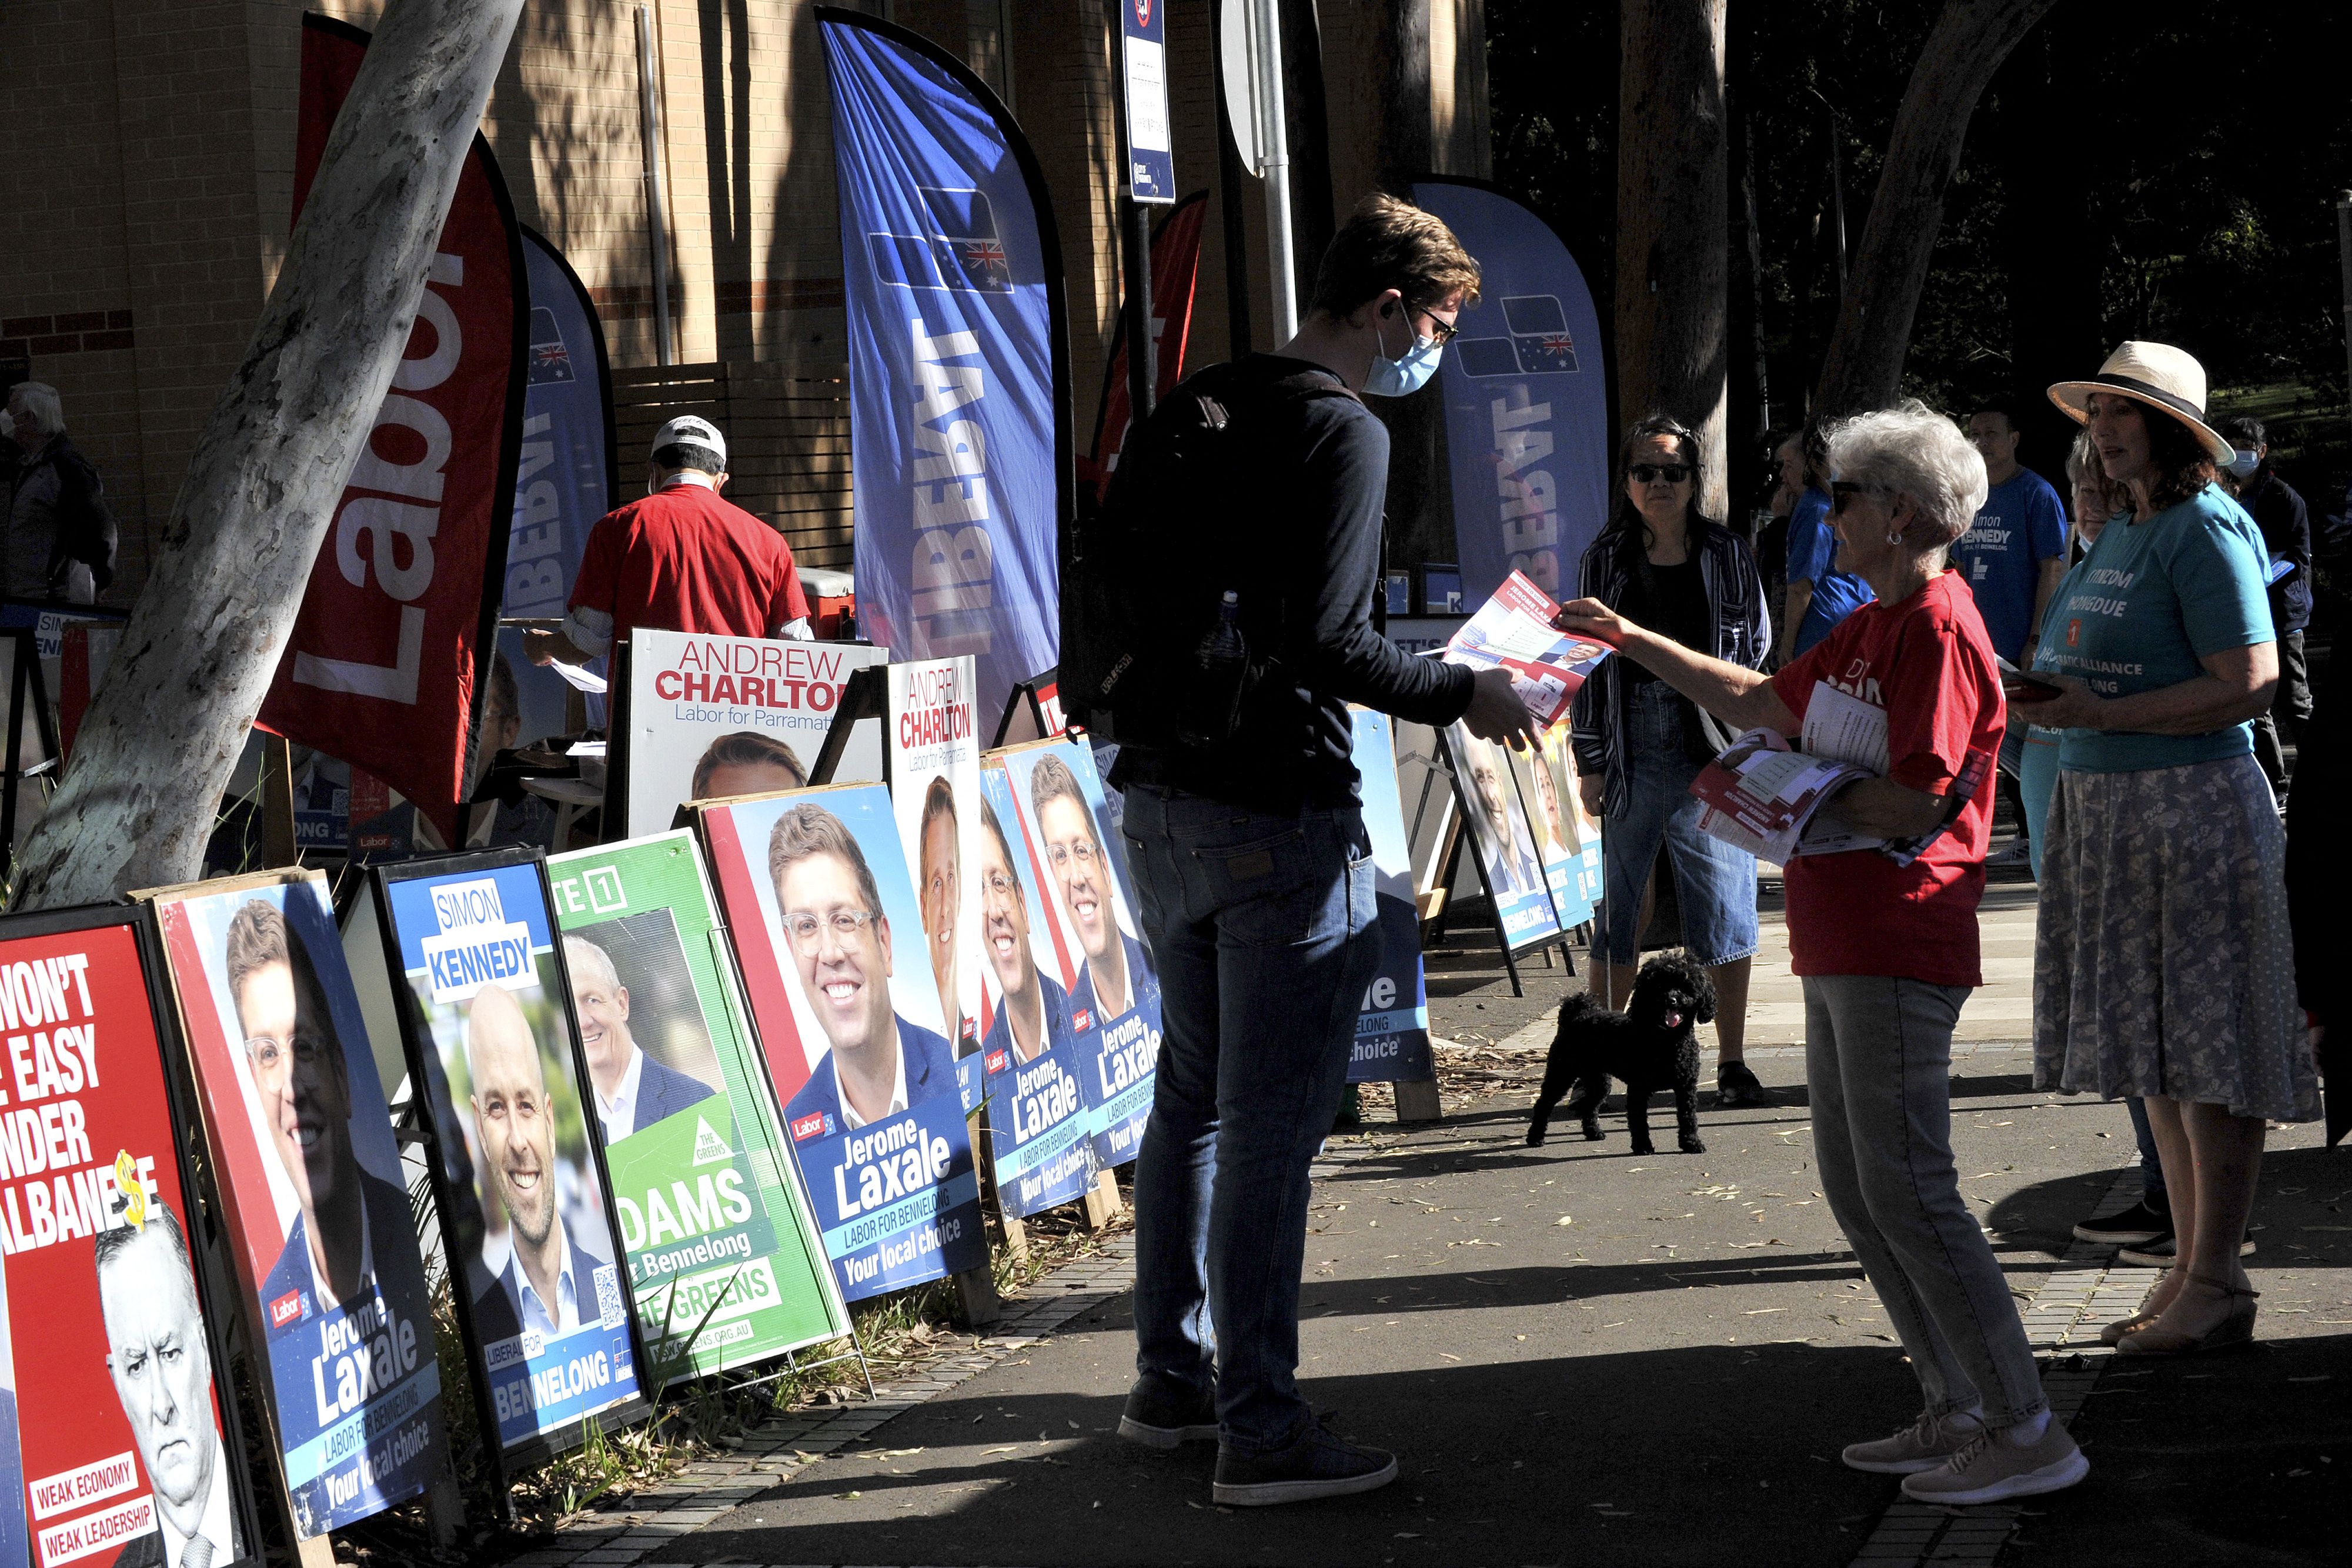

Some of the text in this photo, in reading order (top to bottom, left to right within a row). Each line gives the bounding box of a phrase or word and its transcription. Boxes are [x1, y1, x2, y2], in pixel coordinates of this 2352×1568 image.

[1506, 590, 1522, 604] LABOR
[1521, 601, 1531, 612] FOR
[1509, 586, 1536, 610] JEROME
[2070, 625, 2076, 641] 1
[679, 641, 843, 681] ANDREW
[2080, 657, 2142, 676] ALLIANCE
[908, 666, 963, 710] ANDREW
[676, 704, 722, 723] Labor
[728, 707, 750, 724] for
[900, 703, 971, 749] CHARLTON
[910, 747, 966, 772] Labor for Parramatta
[361, 837, 387, 847] Labor
[437, 888, 500, 929] SIMON
[597, 875, 612, 901] 1
[429, 937, 529, 990] KENNEDY
[963, 1021, 973, 1036] Labor
[1101, 1014, 1142, 1057] Jerome
[8, 1023, 99, 1102] EASY
[988, 1055, 1003, 1071] Labor
[1015, 1058, 1057, 1101] Jerome
[1097, 1022, 1161, 1100] Laxale
[1011, 1066, 1077, 1145] Laxale
[1107, 1098, 1127, 1123] LABOR
[1127, 1092, 1138, 1111] FOR
[700, 1134, 714, 1146] THE
[794, 1118, 821, 1138] Labor
[844, 1118, 917, 1170] Jerome
[1020, 1120, 1078, 1170] LABOR FOR BENNELONG
[1108, 1125, 1130, 1154] Your
[696, 1144, 726, 1160] GREENS
[834, 1127, 951, 1221] Laxale
[1020, 1174, 1043, 1202] Your
[1041, 1155, 1064, 1191] local
[1063, 1142, 1085, 1178] choice
[615, 1168, 752, 1254] DAMS
[844, 1188, 950, 1249] LABOR FOR BENNELONG
[642, 1232, 753, 1277] Bennelong
[844, 1252, 879, 1286] Your
[880, 1231, 917, 1272] local
[918, 1218, 961, 1255] choice
[273, 1297, 298, 1322] Labor
[673, 1268, 770, 1321] GREENS
[320, 1296, 386, 1363] Jerome
[487, 1335, 541, 1366] LIBERAL FOR
[312, 1308, 417, 1427] Laxale
[494, 1350, 610, 1423] BENNELONG
[324, 1383, 419, 1463] LABOR FOR BENNELONG
[36, 1460, 130, 1510] WEAK ECONOMY
[325, 1467, 359, 1510] Your
[359, 1438, 394, 1490] local
[393, 1420, 429, 1467] choice
[45, 1505, 150, 1559] WEAK LEADERSHIP
